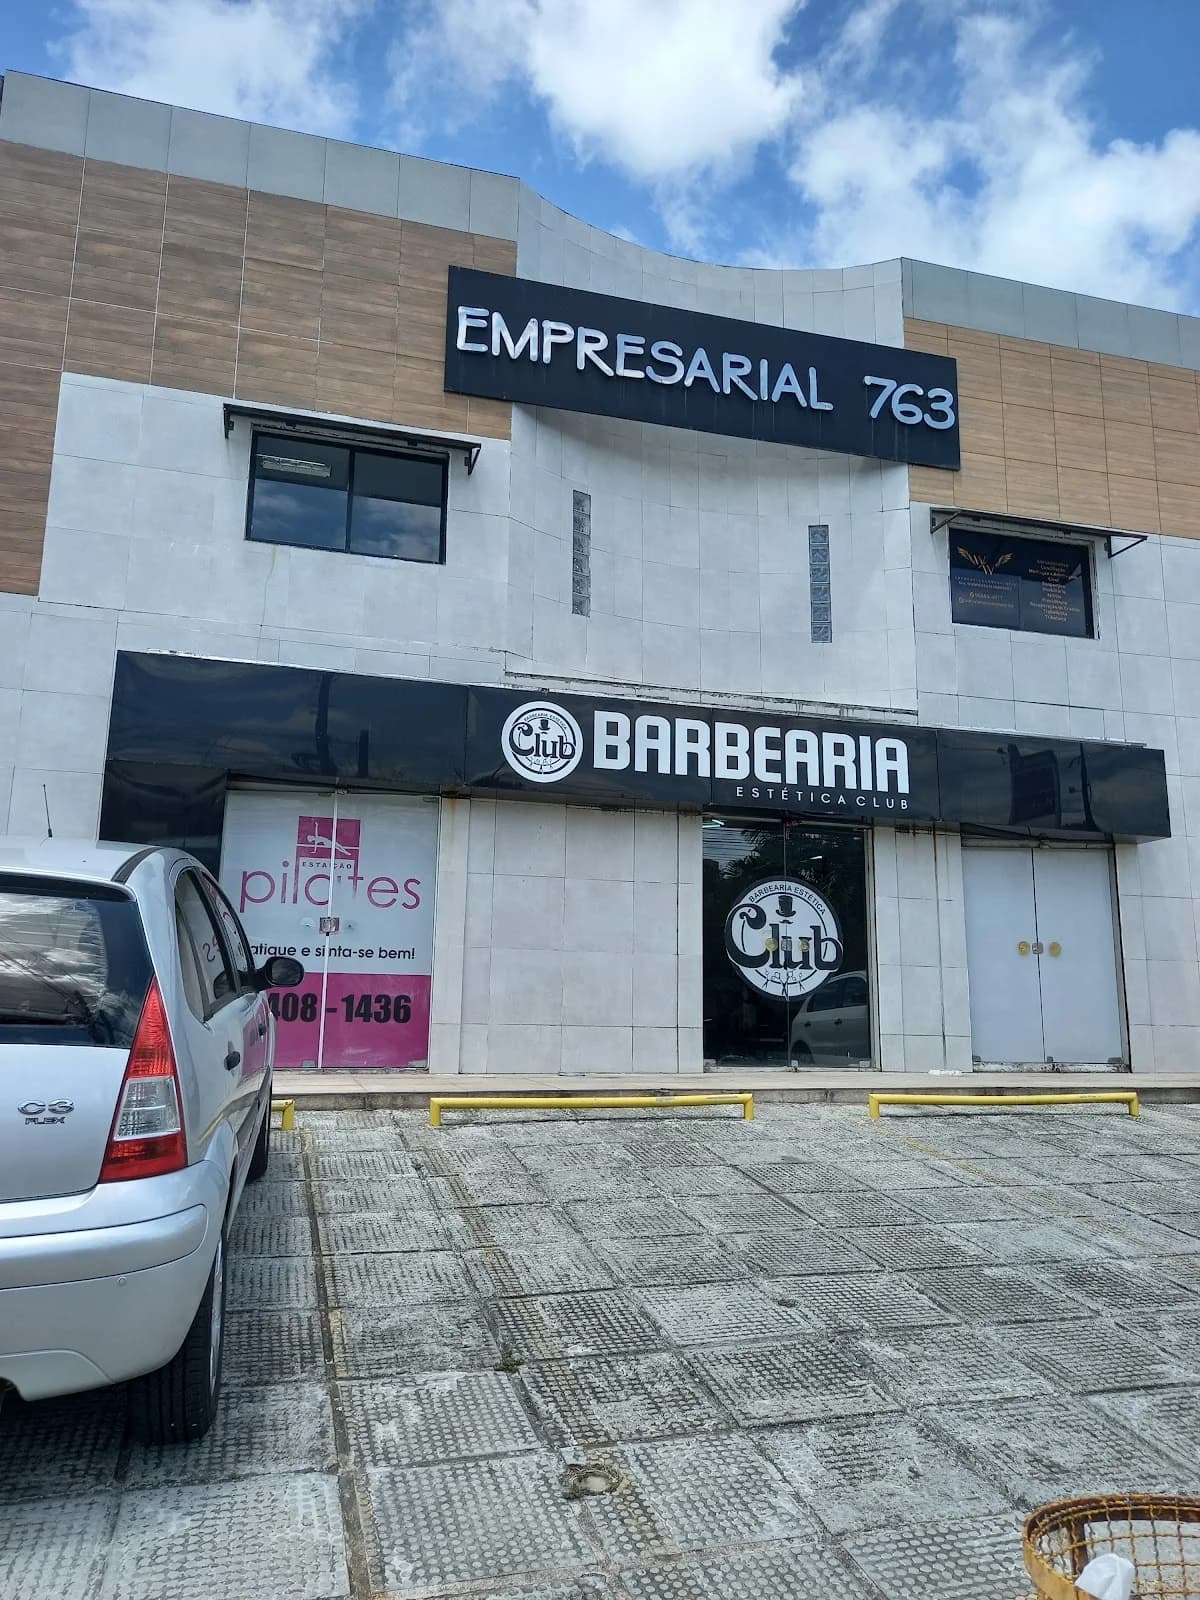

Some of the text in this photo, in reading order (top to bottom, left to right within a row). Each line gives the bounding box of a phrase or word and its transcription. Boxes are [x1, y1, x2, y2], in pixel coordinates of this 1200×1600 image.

[456, 305, 956, 430] EMPRESARIAL 763
[508, 721, 576, 760] Club
[593, 709, 910, 794] BARBEARIA
[736, 786, 908, 810] ESTÉTICA CLUB
[239, 860, 422, 913] pilates
[748, 884, 792, 903] BARBEARIA
[251, 943, 416, 960] atique e sinta-se bem!
[724, 903, 844, 971] Club
[17, 1099, 75, 1116] C3
[25, 1116, 66, 1126] FLEX
